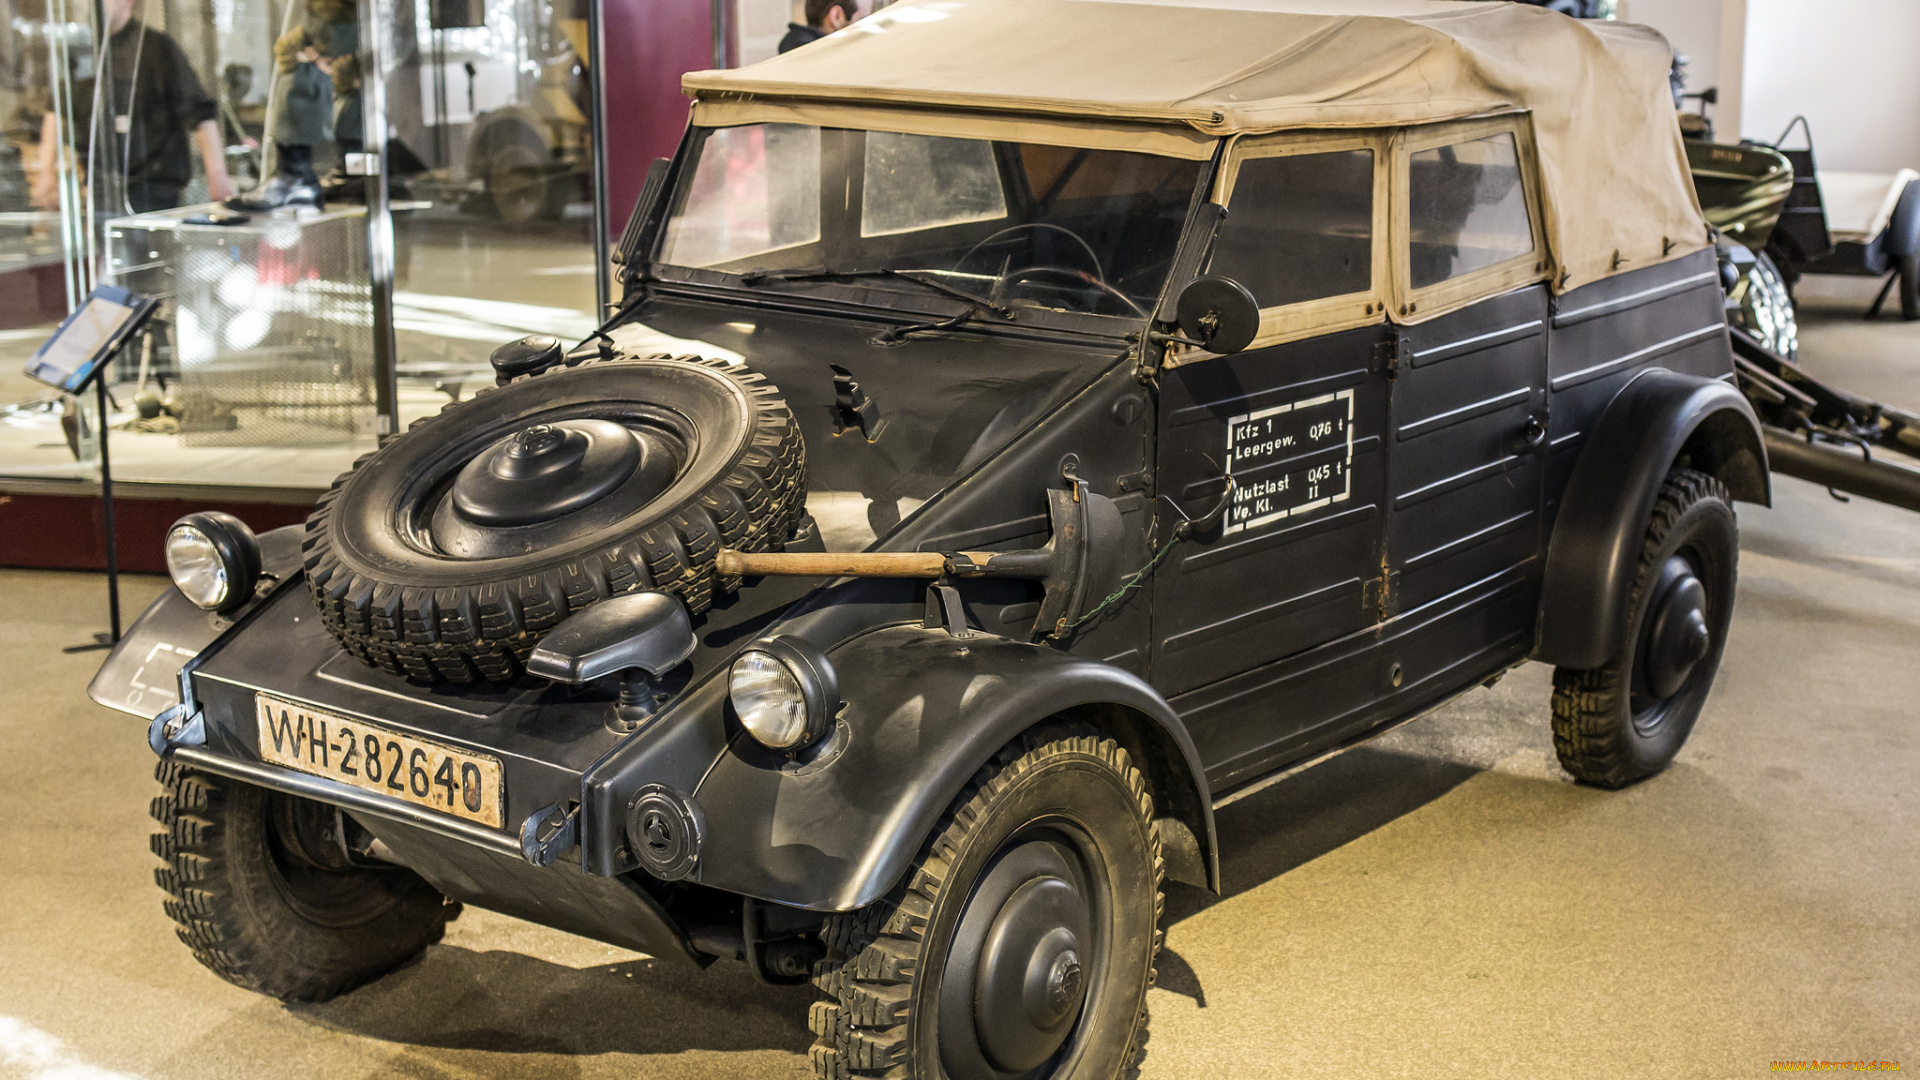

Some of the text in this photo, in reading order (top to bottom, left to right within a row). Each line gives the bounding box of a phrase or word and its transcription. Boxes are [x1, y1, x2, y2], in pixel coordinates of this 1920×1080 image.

[1235, 435, 1297, 460] Leergew.
[1338, 418, 1344, 431] t
[1236, 418, 1273, 441] Kfz 1
[1233, 474, 1290, 503] Nutzlast
[1336, 461, 1342, 475] t
[1233, 505, 1252, 520] Ve.
[1255, 499, 1274, 513] Kl.
[265, 704, 482, 813] WH-282640
